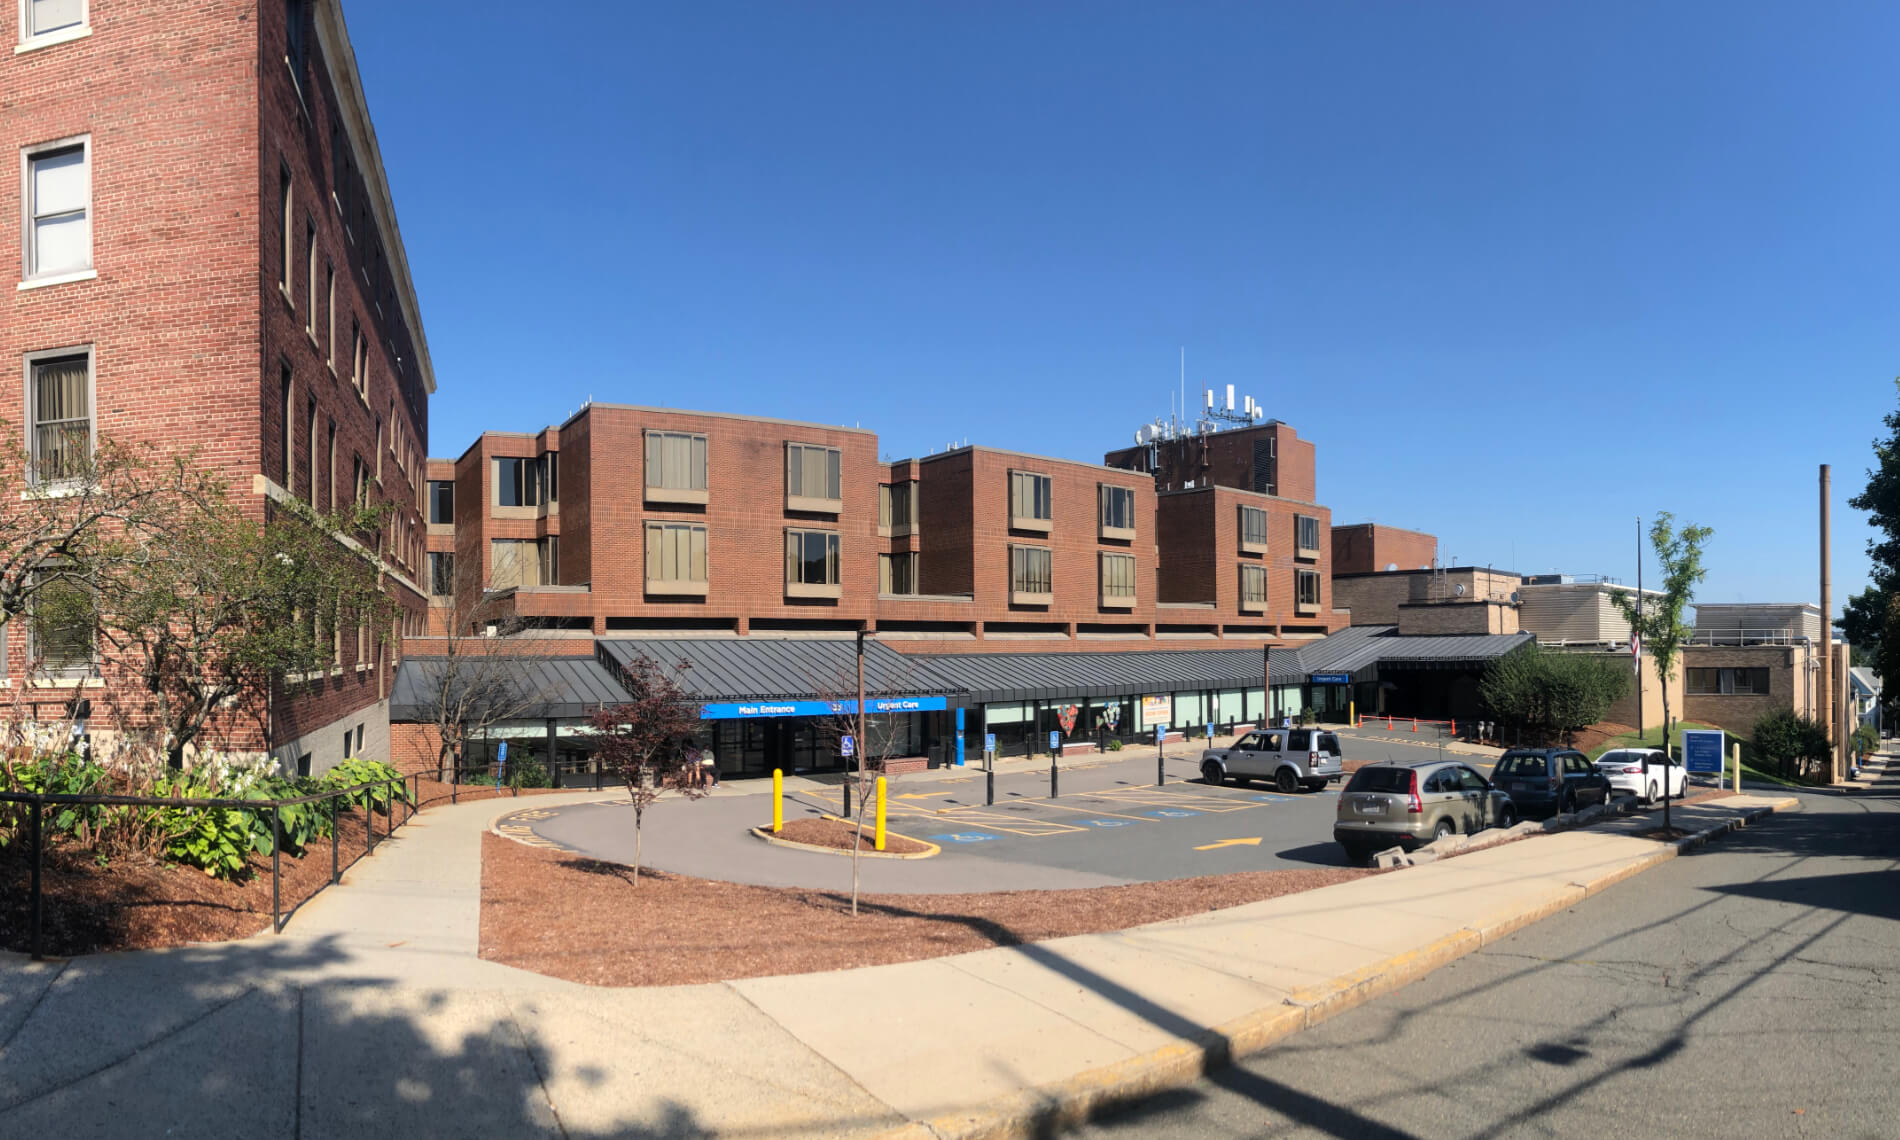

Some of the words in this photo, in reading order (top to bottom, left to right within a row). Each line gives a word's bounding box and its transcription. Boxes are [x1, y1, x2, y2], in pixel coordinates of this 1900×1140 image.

[738, 705, 758, 715] Main
[759, 705, 795, 714] Entrance
[877, 702, 901, 711] Urgent
[902, 701, 919, 709] Care
